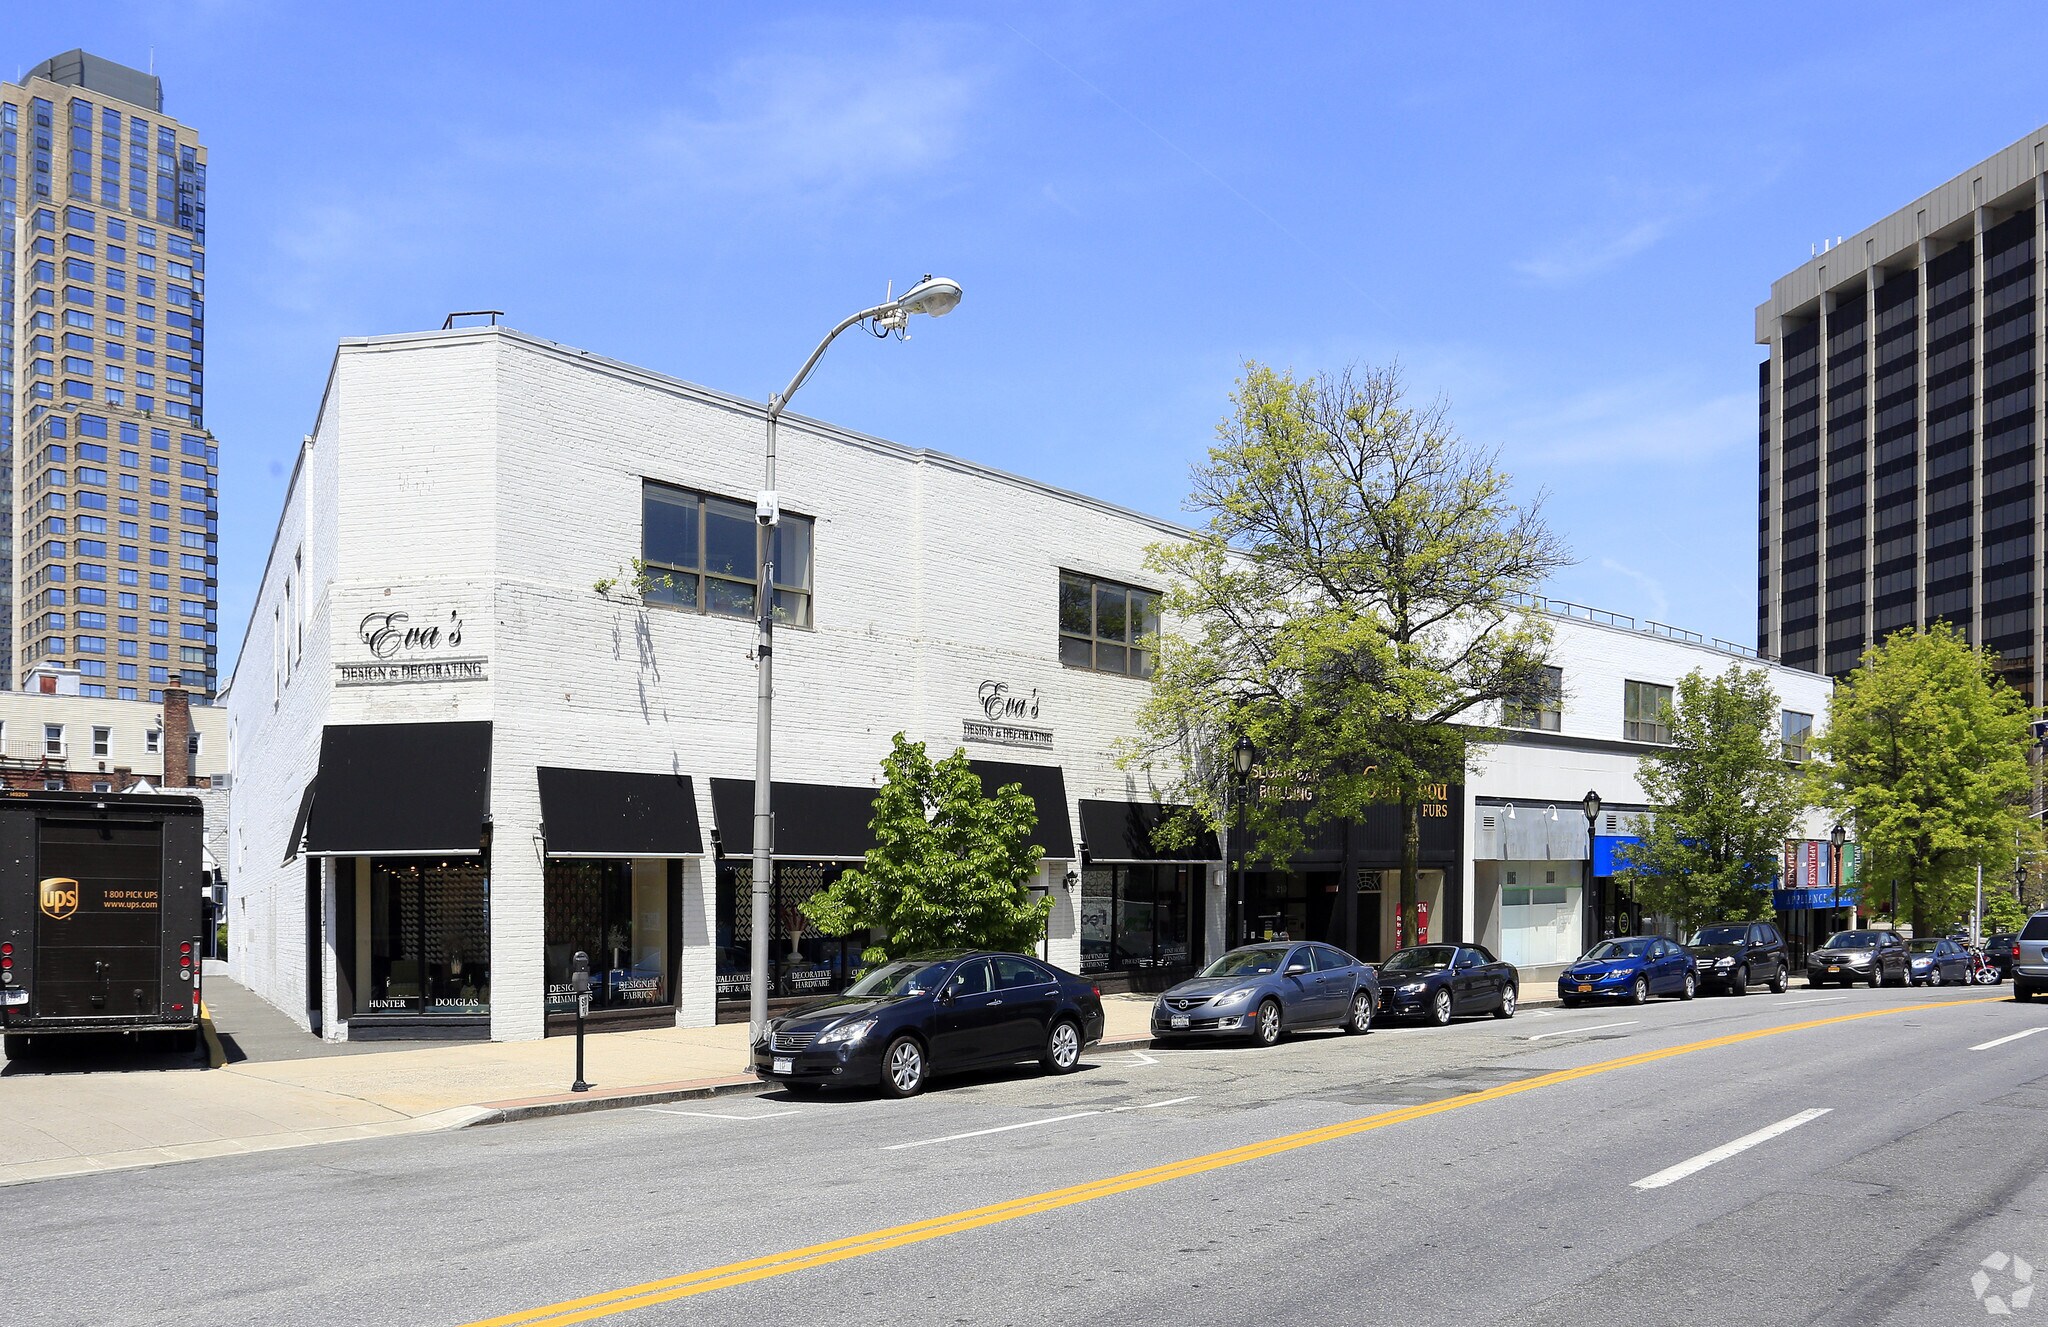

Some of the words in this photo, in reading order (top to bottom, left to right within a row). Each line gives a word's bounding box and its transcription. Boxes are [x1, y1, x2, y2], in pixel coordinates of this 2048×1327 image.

[359, 610, 463, 659] Eva's
[341, 666, 387, 680] DESIGN
[389, 668, 399, 678] &
[401, 662, 482, 679] DECORATING
[978, 680, 1040, 720] Eva's
[963, 723, 994, 738] DESIGN
[995, 729, 1002, 738] &
[1003, 729, 1053, 743] DECORATING
[1422, 804, 1448, 817] FURS
[1808, 844, 1816, 884] APPLIANCES
[109, 891, 124, 899] 800
[125, 891, 142, 899] PICK
[144, 891, 158, 899] UPS
[43, 890, 76, 914] ups
[103, 901, 158, 909] www.ups.com
[791, 970, 832, 978] DECORATIVE
[549, 982, 592, 993] DESIGR
[618, 980, 658, 989] DESIGNER
[795, 980, 830, 989] HARDWARE
[547, 993, 593, 1004] TRIMMIS
[623, 990, 654, 1000] FABRICS
[368, 999, 406, 1008] HUNTER
[435, 998, 479, 1007] DOUGLAS
